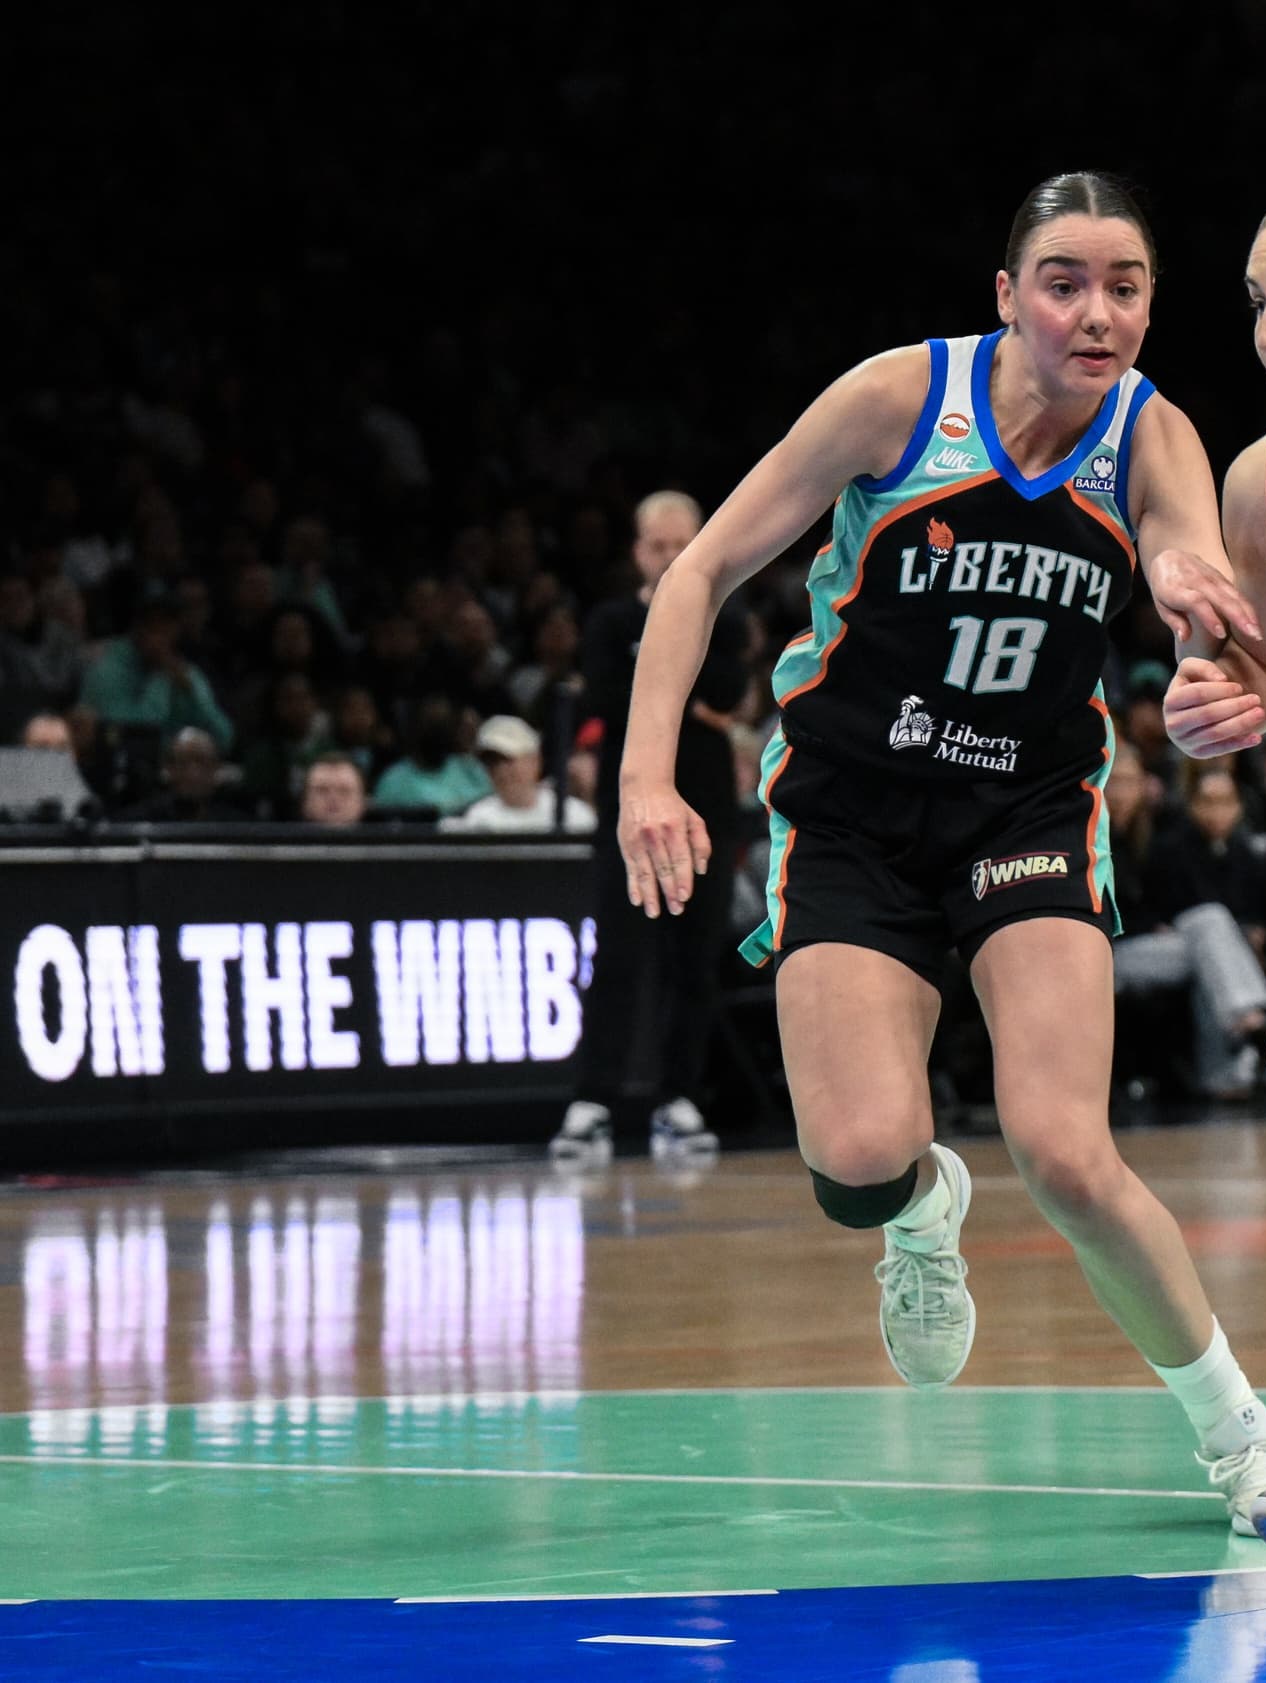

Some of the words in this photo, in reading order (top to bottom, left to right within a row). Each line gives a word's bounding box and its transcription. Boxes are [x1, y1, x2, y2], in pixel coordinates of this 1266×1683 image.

[935, 446, 978, 470] NIKE
[899, 540, 1113, 621] LIBERTY
[943, 615, 1048, 695] 18
[933, 741, 1017, 772] Mutual
[941, 720, 1022, 757] Liberty
[990, 855, 1068, 886] WNBA
[14, 923, 165, 1082] ON
[179, 920, 360, 1074] THE
[371, 916, 598, 1066] WNB
